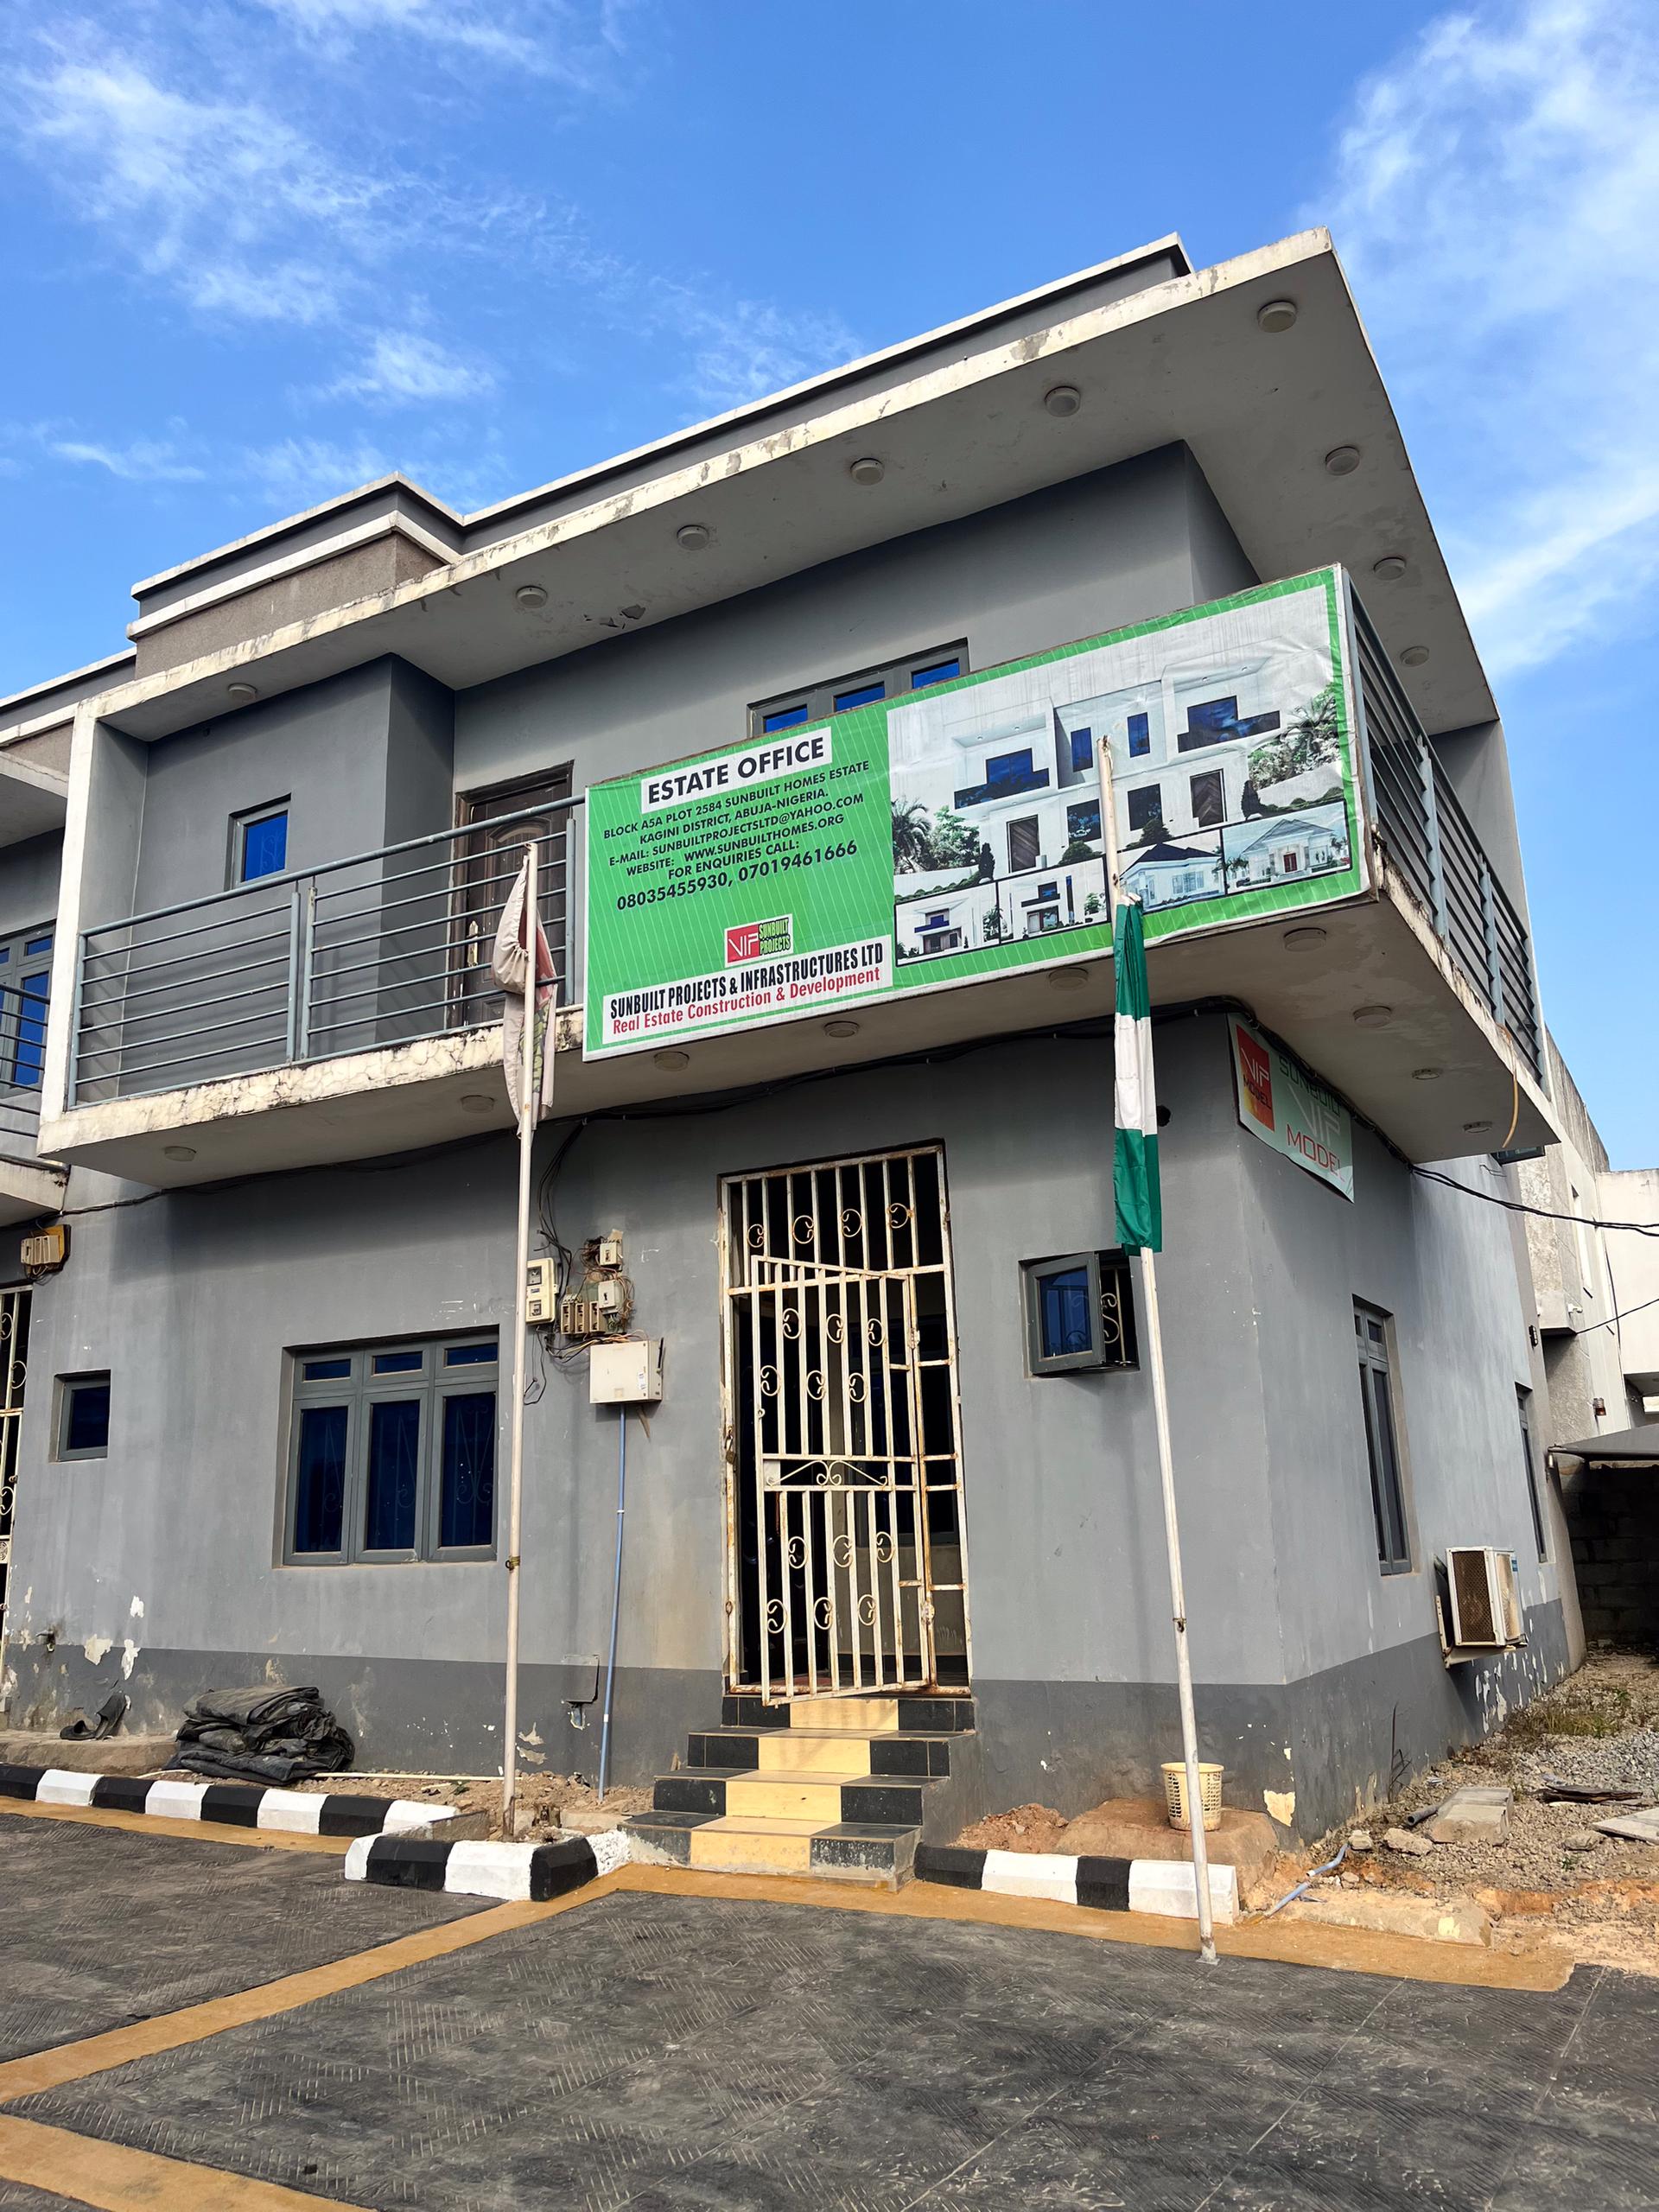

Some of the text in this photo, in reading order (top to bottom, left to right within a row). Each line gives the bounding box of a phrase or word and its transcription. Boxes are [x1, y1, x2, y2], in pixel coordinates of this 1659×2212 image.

[604, 760, 869, 839] BLOCK A5A PLOT 2584 SUNBUILT HOMES ESTATE
[649, 737, 823, 804] ESTATE OFFICE
[609, 793, 863, 866] E-MAIL: SUNBUILTPROJECTSLTD@YAHOO.COM
[626, 814, 844, 876] WEBSITE: WWW.SUNBUILTHOMES.ORG
[640, 788, 829, 844] KAGINI DISTRICT, ABUJA-NIGERIA.
[617, 840, 857, 911] 08035455930, 07019461666
[668, 839, 799, 880] FOR ENQUIRIES CALL:
[759, 918, 789, 939] SUNBUILT
[760, 934, 791, 955] PROJECTS
[611, 943, 883, 1019] SUNBUILT PROJECTS & INFRASTRUCTURES LTD
[613, 967, 880, 1034] Real Estate Construction & Development
[1241, 1048, 1270, 1086] VIP
[1287, 1123, 1345, 1183] MODEL
